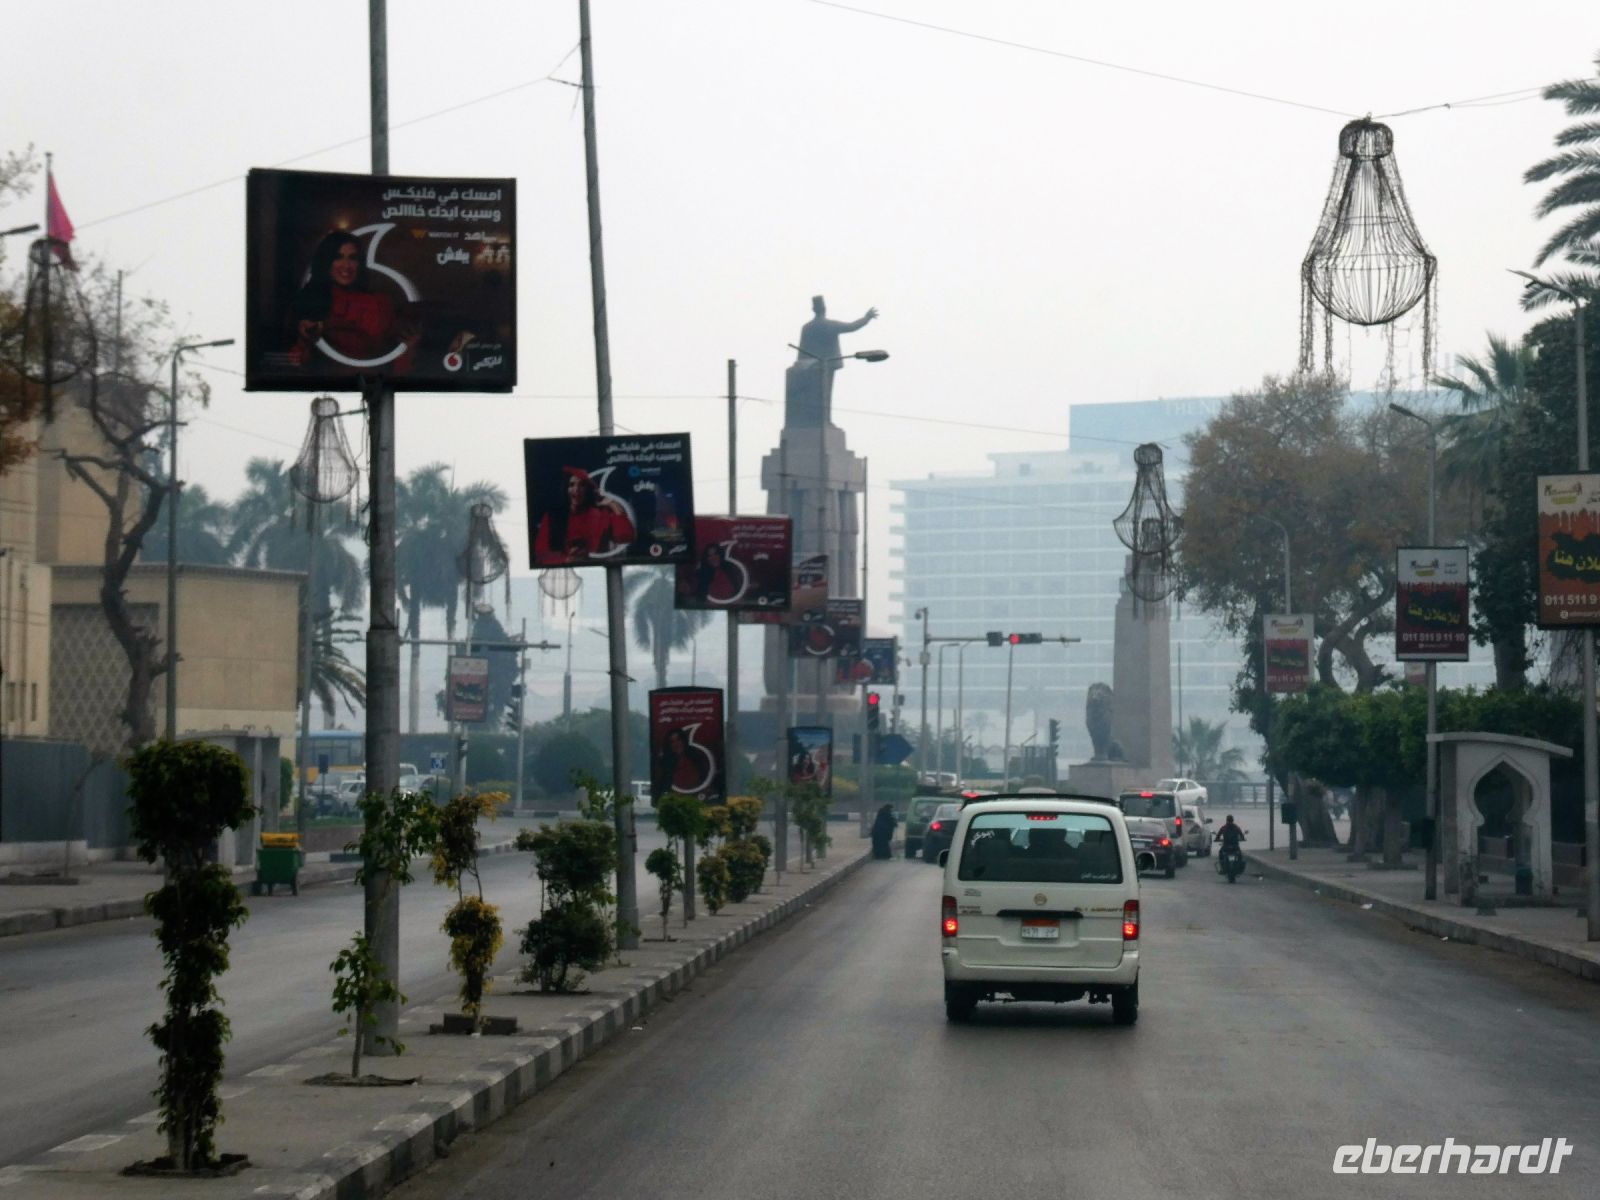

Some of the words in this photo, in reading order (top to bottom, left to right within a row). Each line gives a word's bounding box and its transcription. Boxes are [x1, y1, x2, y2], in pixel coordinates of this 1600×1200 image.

[382, 186, 436, 202] فليكس
[437, 187, 459, 205] في
[461, 187, 502, 201] امسك
[428, 205, 459, 221] ايدك
[460, 207, 502, 222] وسيب
[1544, 594, 1565, 606] 011
[1567, 593, 1587, 606] 511
[1402, 632, 1418, 642] 011
[1419, 632, 1435, 642] 511
